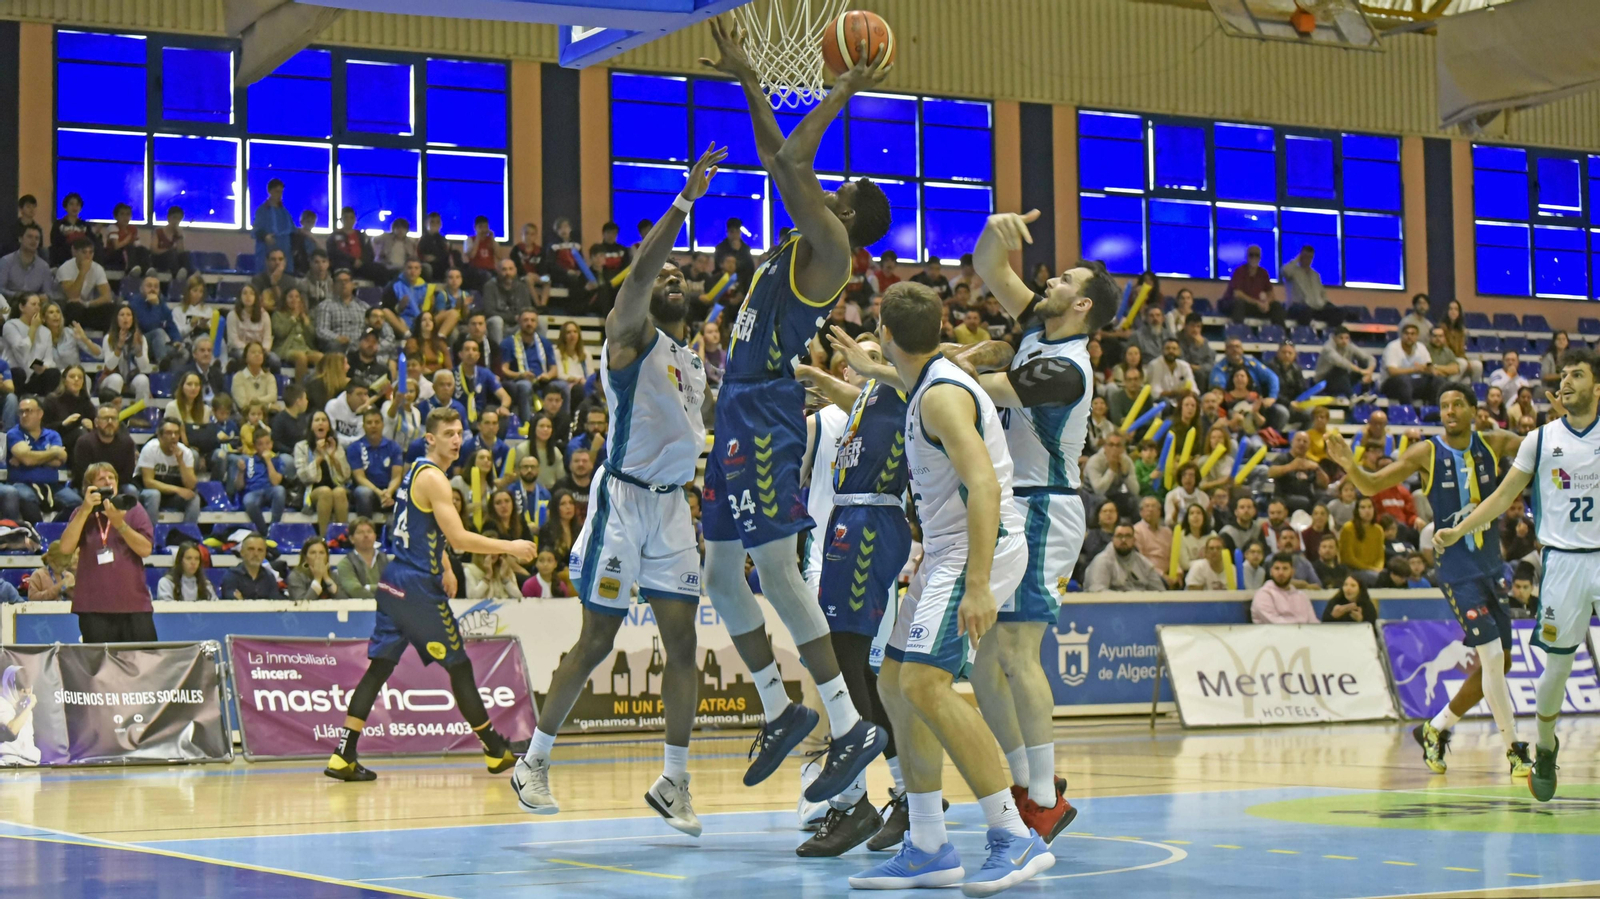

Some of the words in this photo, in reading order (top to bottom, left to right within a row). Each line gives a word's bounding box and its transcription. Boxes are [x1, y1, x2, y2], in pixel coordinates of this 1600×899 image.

[727, 488, 757, 520] 34
[1569, 496, 1594, 523] 22
[248, 652, 263, 665] La
[266, 651, 337, 666] inmobiliaria
[251, 666, 302, 680] sincera.
[1098, 667, 1113, 680] de
[1197, 670, 1359, 697] Mercure
[54, 687, 104, 706] SÍGUENOS
[105, 692, 120, 706] EN
[121, 691, 156, 706] REDES
[157, 688, 204, 704] SOCIALES
[613, 701, 628, 714] NI
[632, 700, 653, 714] UN
[698, 698, 746, 712] ATRAS
[1262, 705, 1319, 718] HOTELS
[389, 722, 416, 736] 856
[417, 722, 447, 736] 044
[446, 721, 474, 736] 403
